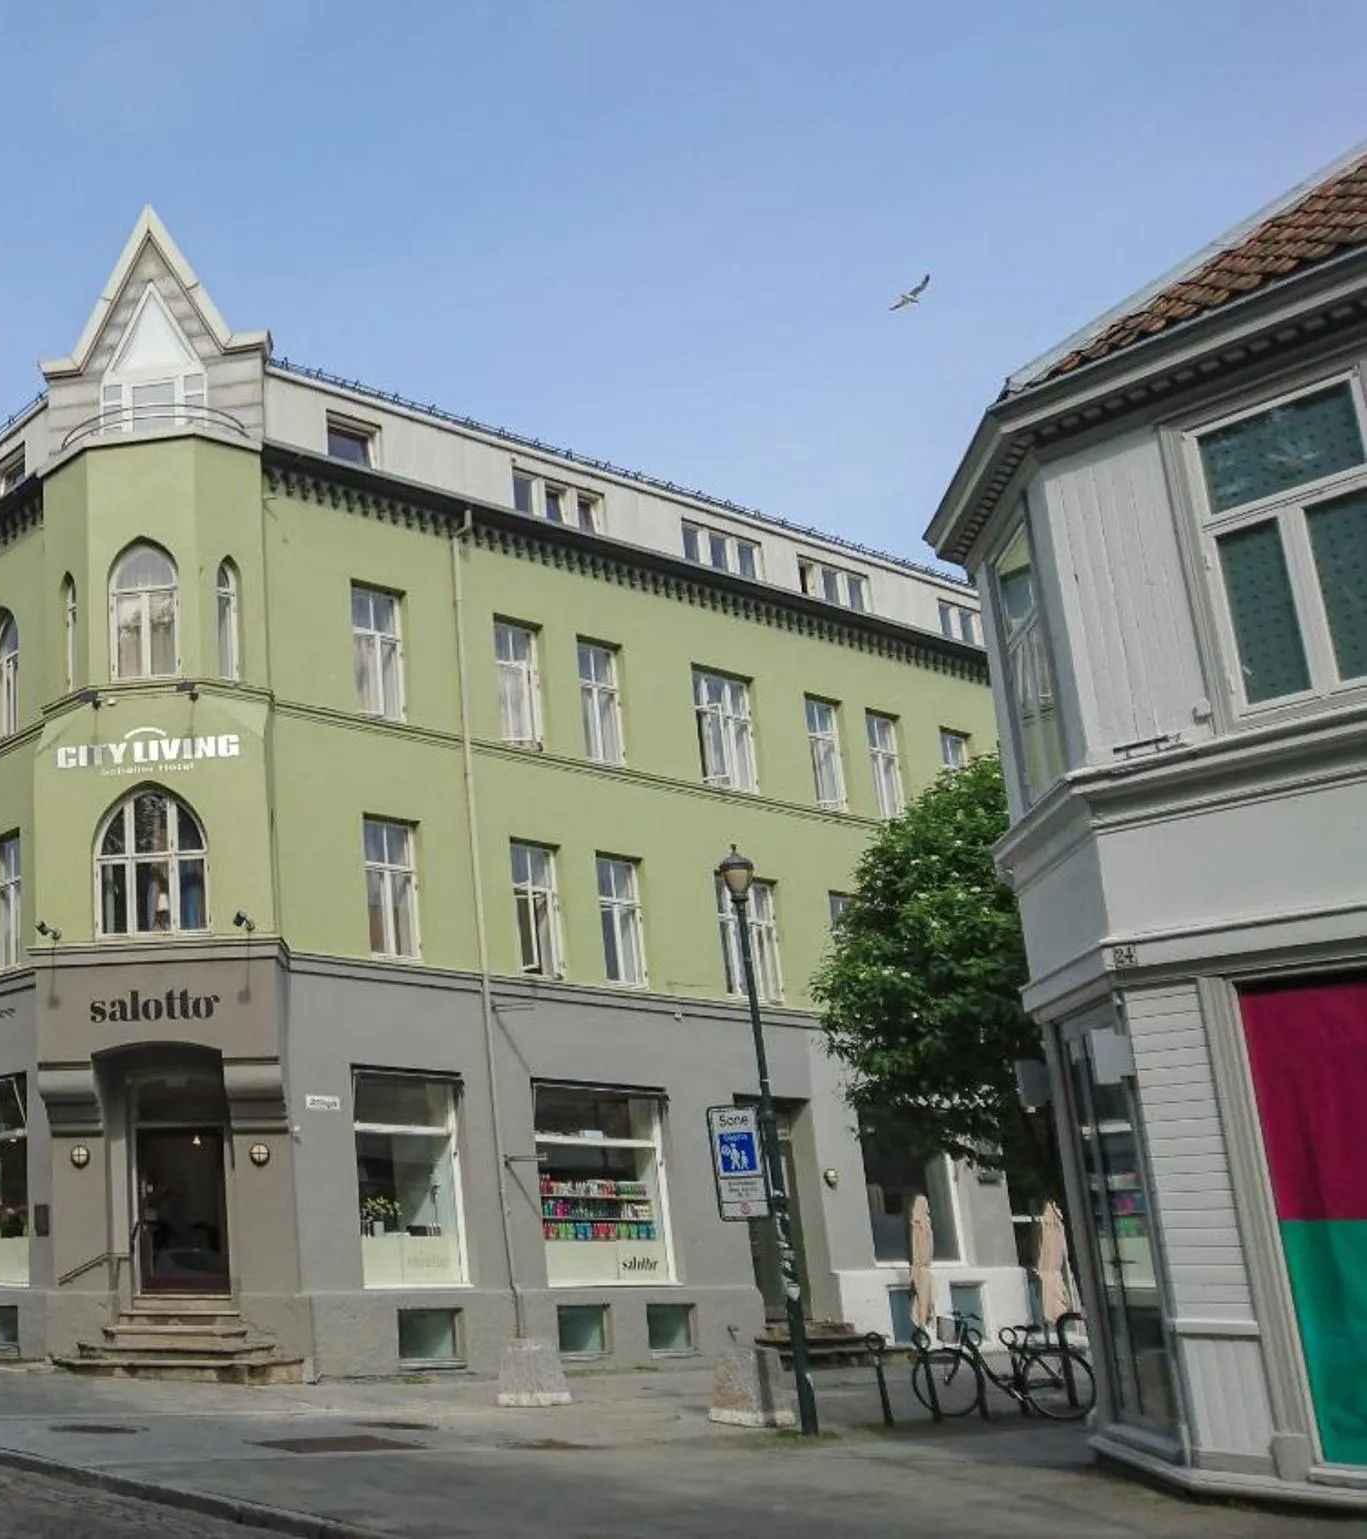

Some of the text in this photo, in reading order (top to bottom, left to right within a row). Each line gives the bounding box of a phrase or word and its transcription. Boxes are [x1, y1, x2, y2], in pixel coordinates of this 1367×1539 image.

[57, 734, 240, 769] CITY LIVING
[90, 989, 220, 1023] salotto
